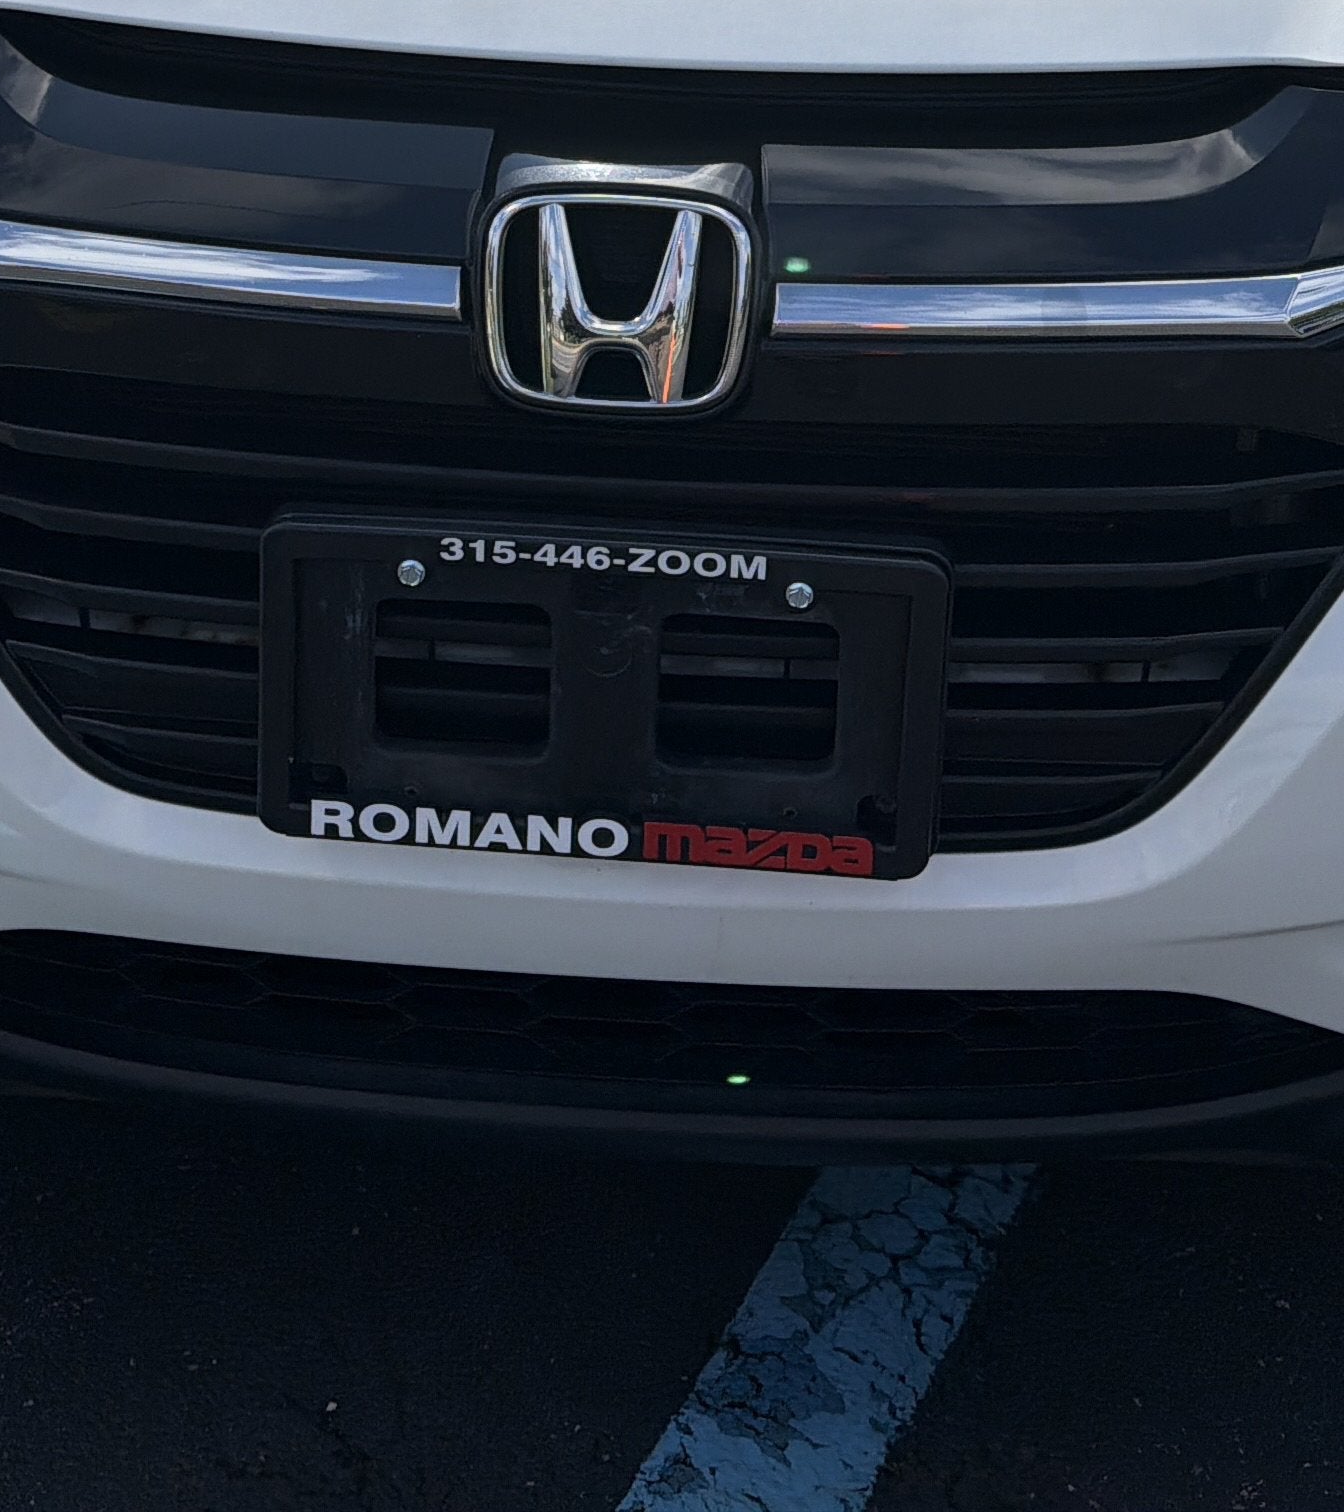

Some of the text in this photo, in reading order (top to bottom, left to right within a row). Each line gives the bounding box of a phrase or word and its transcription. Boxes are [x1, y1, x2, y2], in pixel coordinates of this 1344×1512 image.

[440, 537, 768, 581] 315-446-ZOOM
[310, 799, 874, 876] ROMANO mazda
